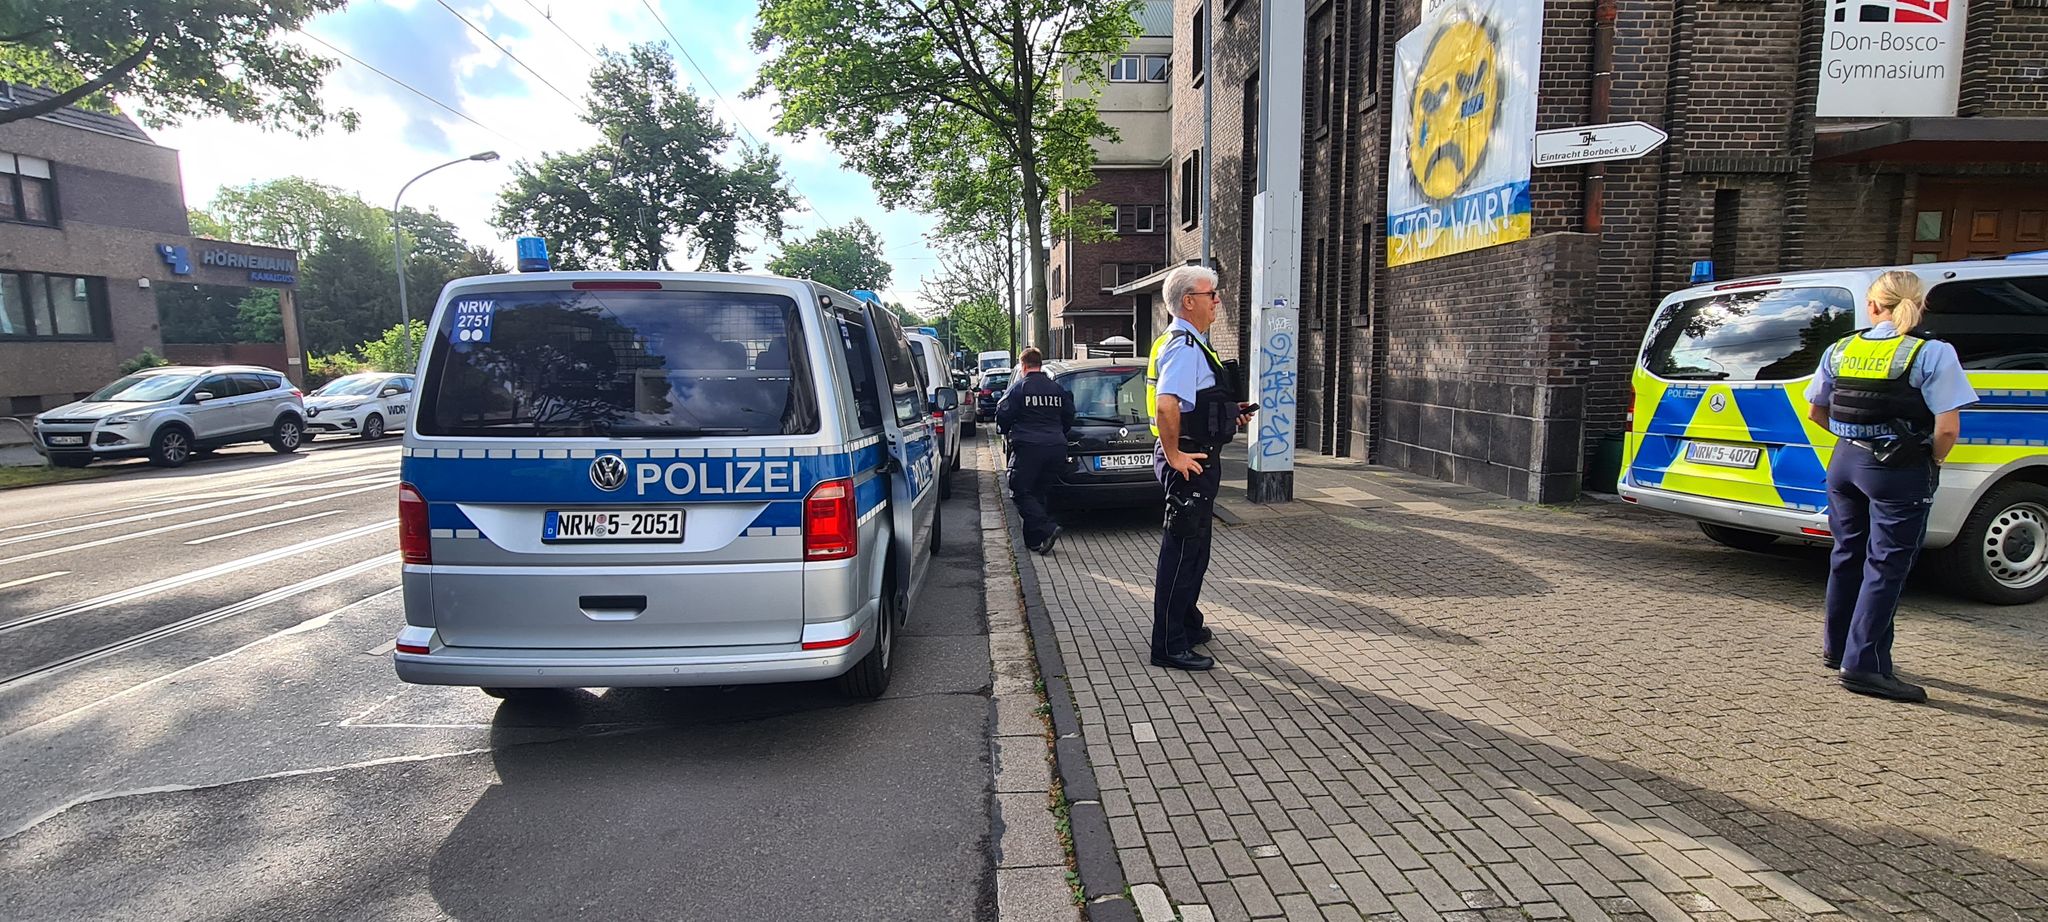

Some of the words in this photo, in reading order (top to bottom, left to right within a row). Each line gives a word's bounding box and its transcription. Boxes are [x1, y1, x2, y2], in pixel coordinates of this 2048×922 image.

[1830, 31, 1946, 51] Don-Bosco-
[1827, 59, 1945, 84] Gymnasium
[1541, 150, 1580, 161] Eintracht
[1583, 147, 1619, 157] Borbeck
[1621, 144, 1637, 154] e.V.
[1393, 208, 1442, 256] STOP
[1450, 187, 1512, 241] WAR!
[204, 249, 294, 272] HÖRNEMANN
[458, 301, 493, 314] NRW
[457, 315, 490, 328] 2751
[387, 405, 406, 415] WDR
[1025, 395, 1062, 407] POLIZEI
[1128, 454, 1152, 465] 1987
[1693, 445, 1713, 460] NRW
[1717, 446, 1758, 464] 5-4070
[636, 461, 800, 496] POLIZEI
[557, 513, 595, 536] NRW
[608, 513, 680, 536] 5-2051
